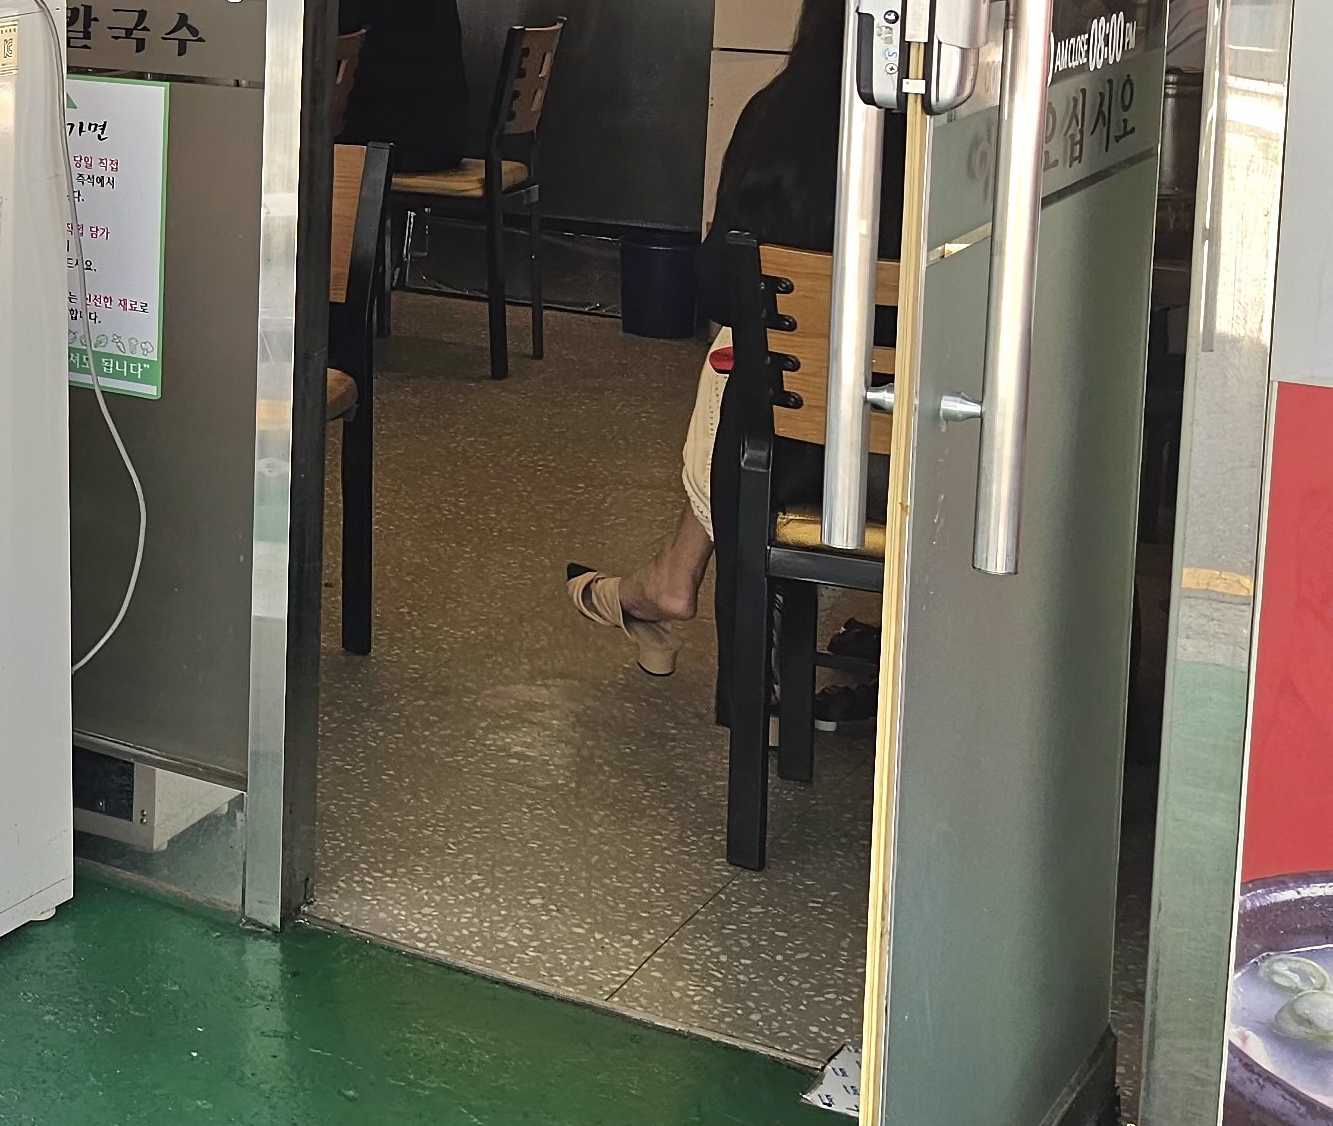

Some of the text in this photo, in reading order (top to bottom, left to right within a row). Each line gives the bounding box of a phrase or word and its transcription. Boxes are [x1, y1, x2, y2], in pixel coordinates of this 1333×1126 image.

[1068, 33, 1089, 68] CLOSE
[1088, 11, 1125, 72] 08:00
[1124, 20, 1137, 51] PM
[73, 154, 119, 173] 당일 직접
[75, 172, 116, 190] 즉석에서
[88, 225, 110, 241] 담가
[117, 298, 149, 314] 재료로
